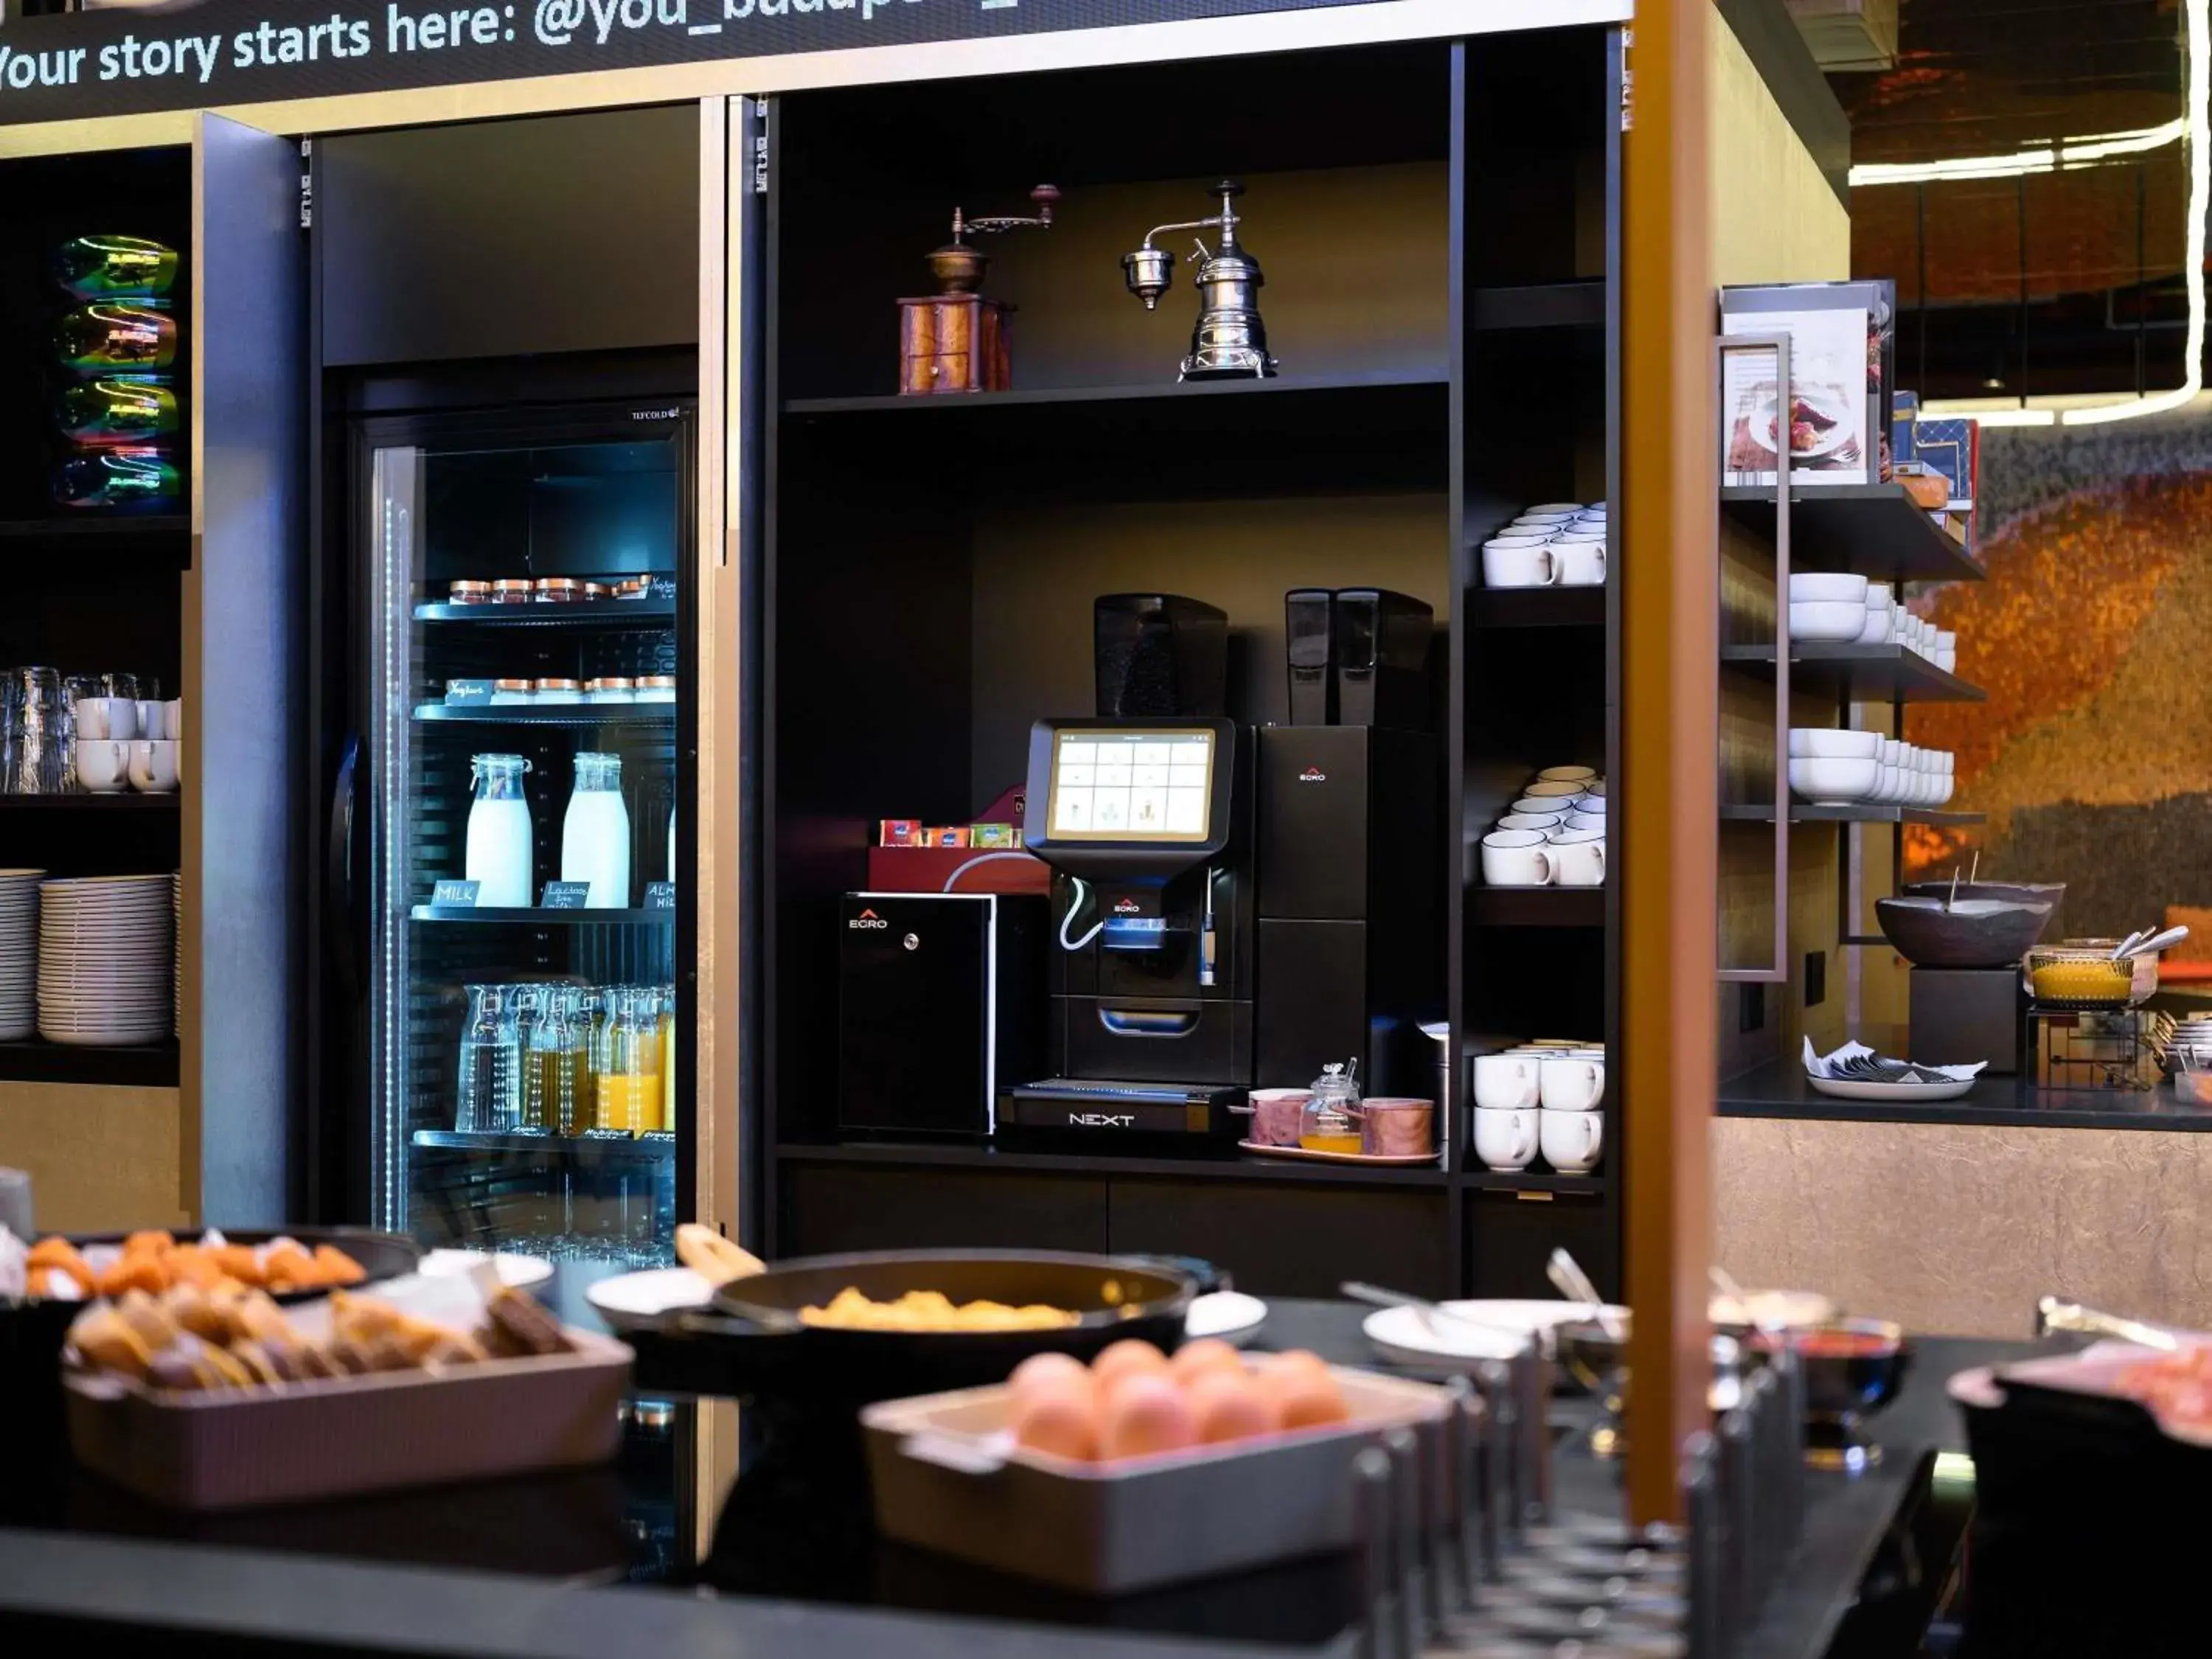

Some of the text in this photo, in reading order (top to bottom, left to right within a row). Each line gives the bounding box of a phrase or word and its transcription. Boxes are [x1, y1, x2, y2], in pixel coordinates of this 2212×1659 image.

[100, 35, 220, 83] story
[233, 14, 369, 68] starts
[387, 3, 515, 53] here:
[437, 885, 473, 902] MILK
[1069, 1113, 1135, 1127] NEXT
